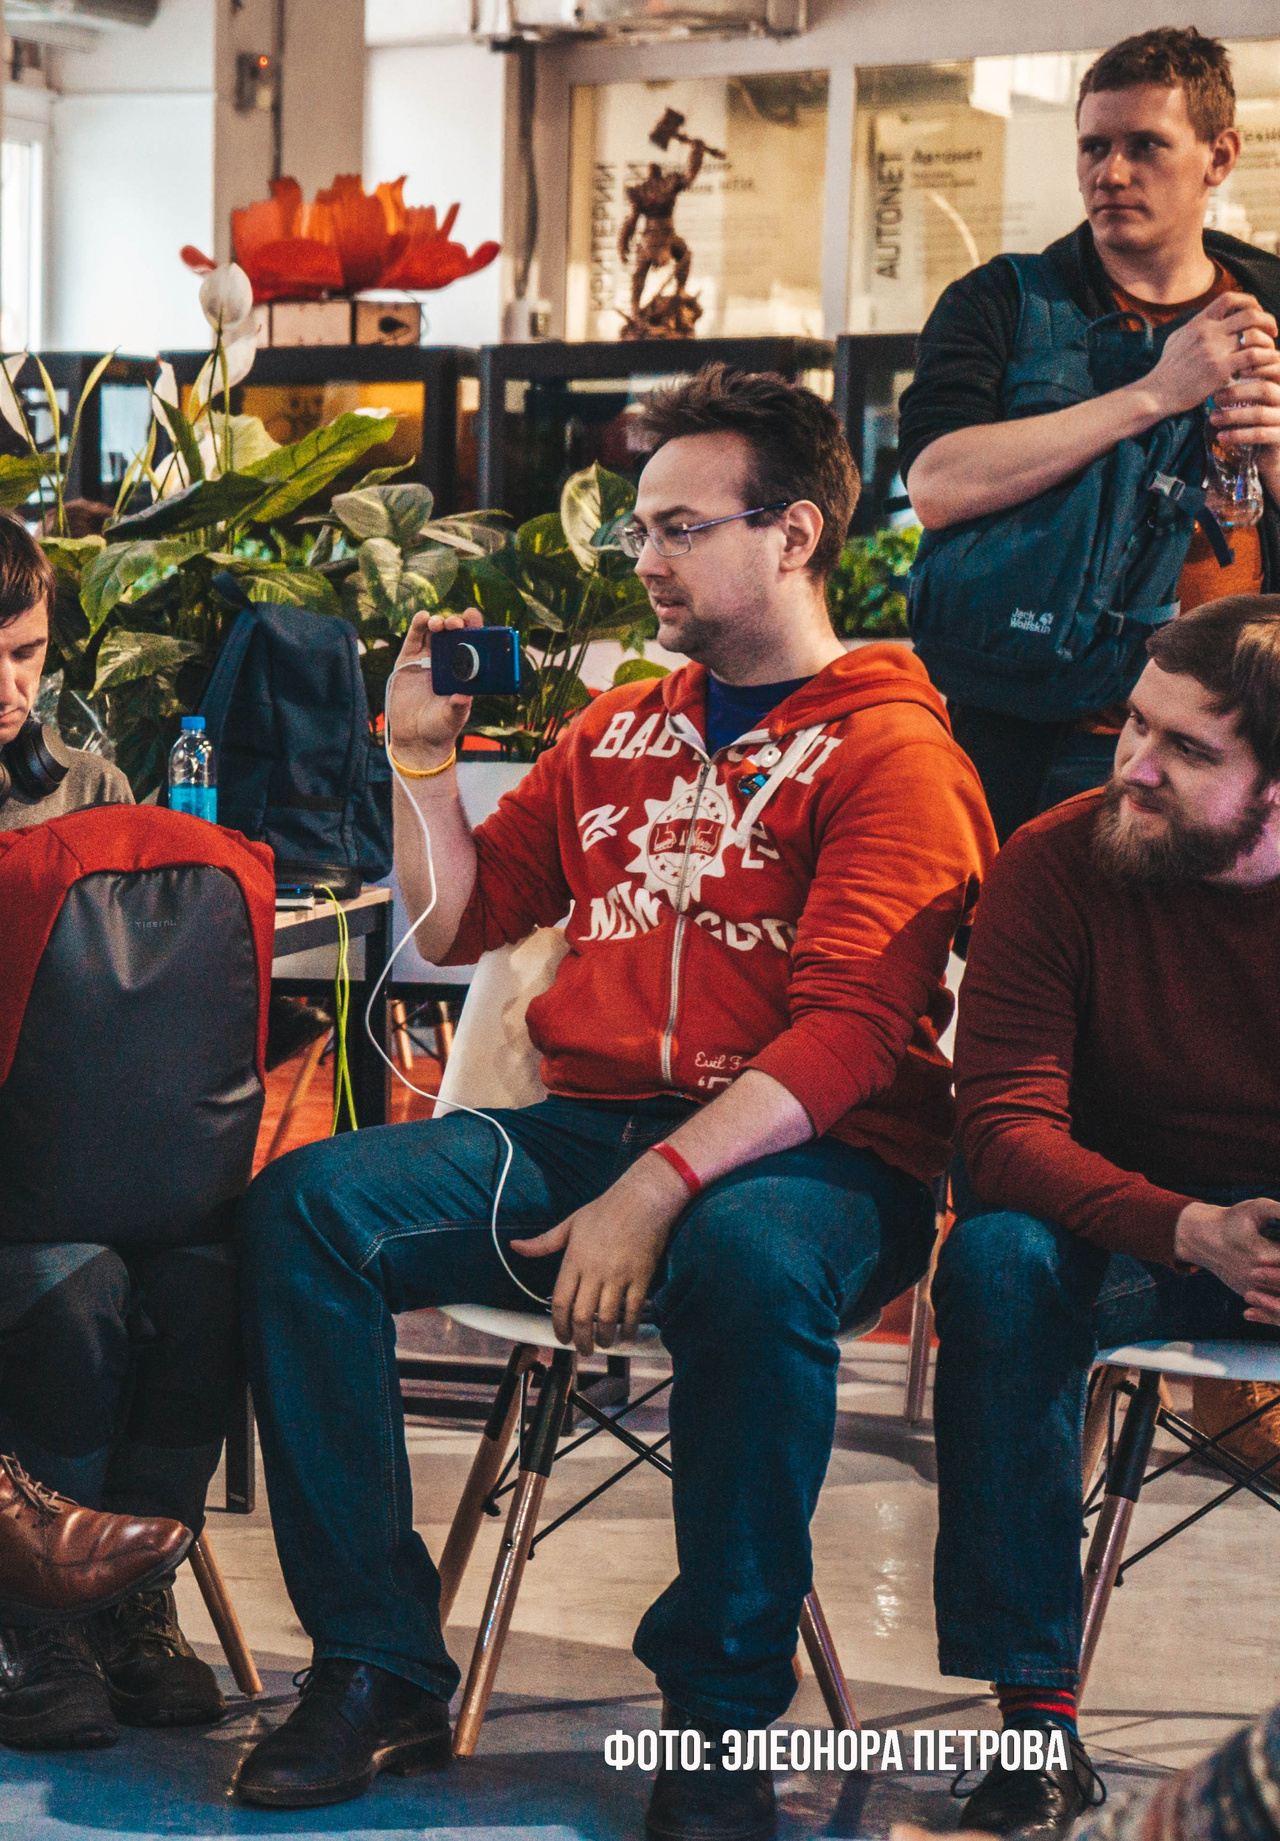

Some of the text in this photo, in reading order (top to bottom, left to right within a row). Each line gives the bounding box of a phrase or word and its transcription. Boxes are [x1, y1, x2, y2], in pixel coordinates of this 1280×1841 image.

[875, 152, 904, 279] AUTONET
[577, 880, 663, 941] NEW
[694, 1051, 726, 1070] Evil
